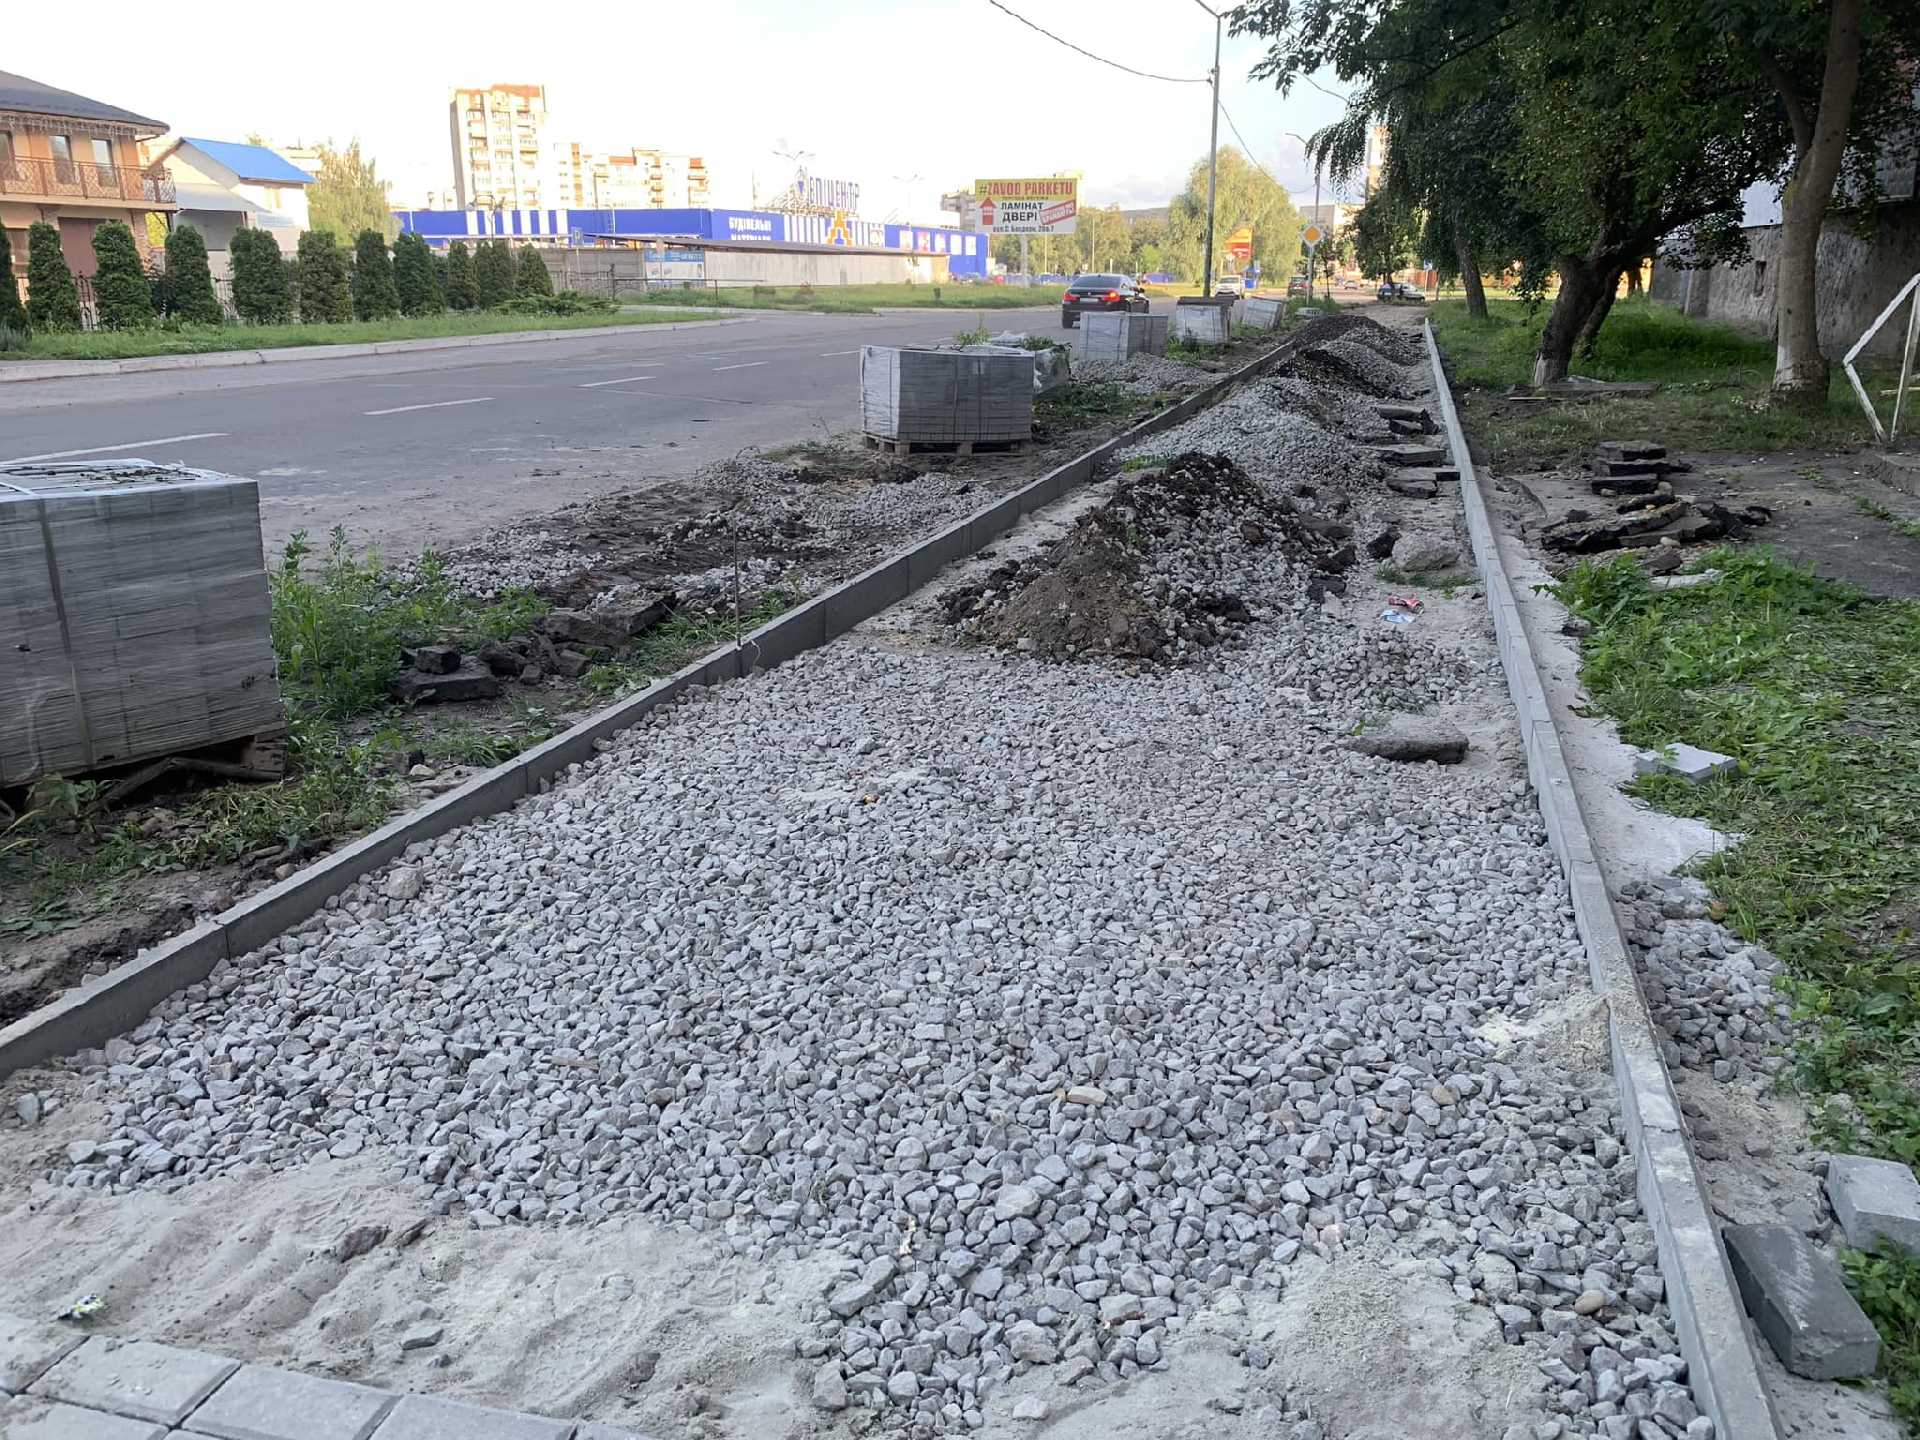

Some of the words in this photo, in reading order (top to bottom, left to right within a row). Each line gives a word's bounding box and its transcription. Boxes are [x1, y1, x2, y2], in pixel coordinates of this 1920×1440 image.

[1024, 181, 1073, 195] PARKETU
[1001, 202, 1044, 210] ЛАМІНАТ
[1002, 212, 1037, 223] ДВЕРІ
